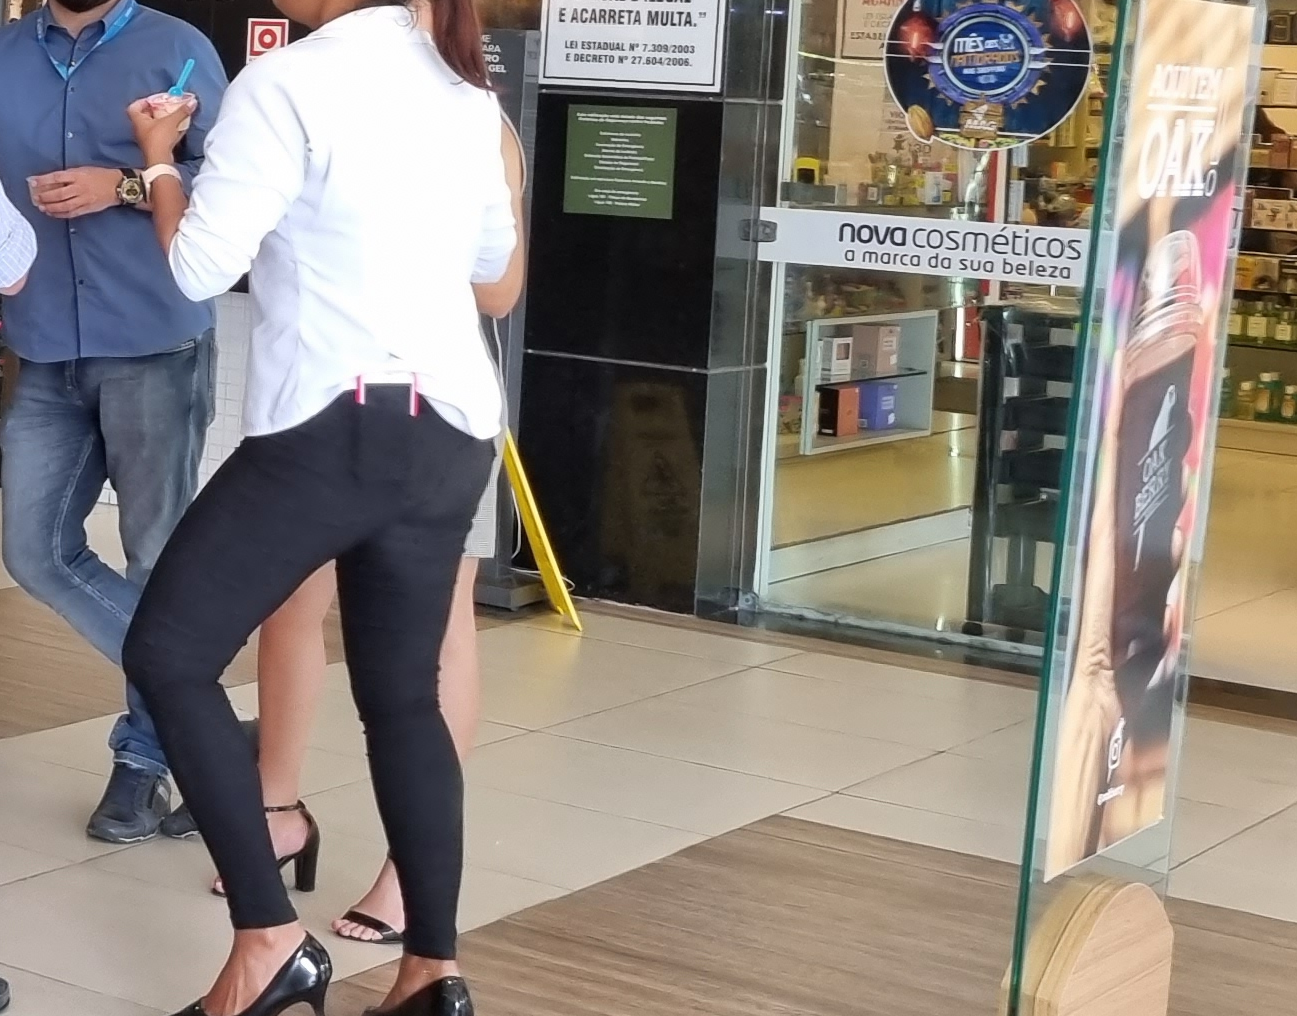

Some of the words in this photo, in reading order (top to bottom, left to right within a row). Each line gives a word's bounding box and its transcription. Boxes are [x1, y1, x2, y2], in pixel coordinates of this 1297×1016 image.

[558, 8, 567, 23] E
[570, 8, 642, 25] ACARRETA
[564, 40, 578, 50] LEI
[581, 41, 625, 52] ESTADUAL
[642, 43, 695, 54] 7.309/2003
[565, 53, 571, 62] E
[574, 53, 615, 64] DECRETO
[488, 64, 507, 73] GEL
[838, 222, 907, 247] nova
[911, 226, 1082, 261] cosméticos
[844, 249, 855, 262] a
[862, 250, 921, 267] marca
[927, 253, 952, 270] da
[958, 258, 995, 274] sua
[1002, 258, 1071, 280] beleza
